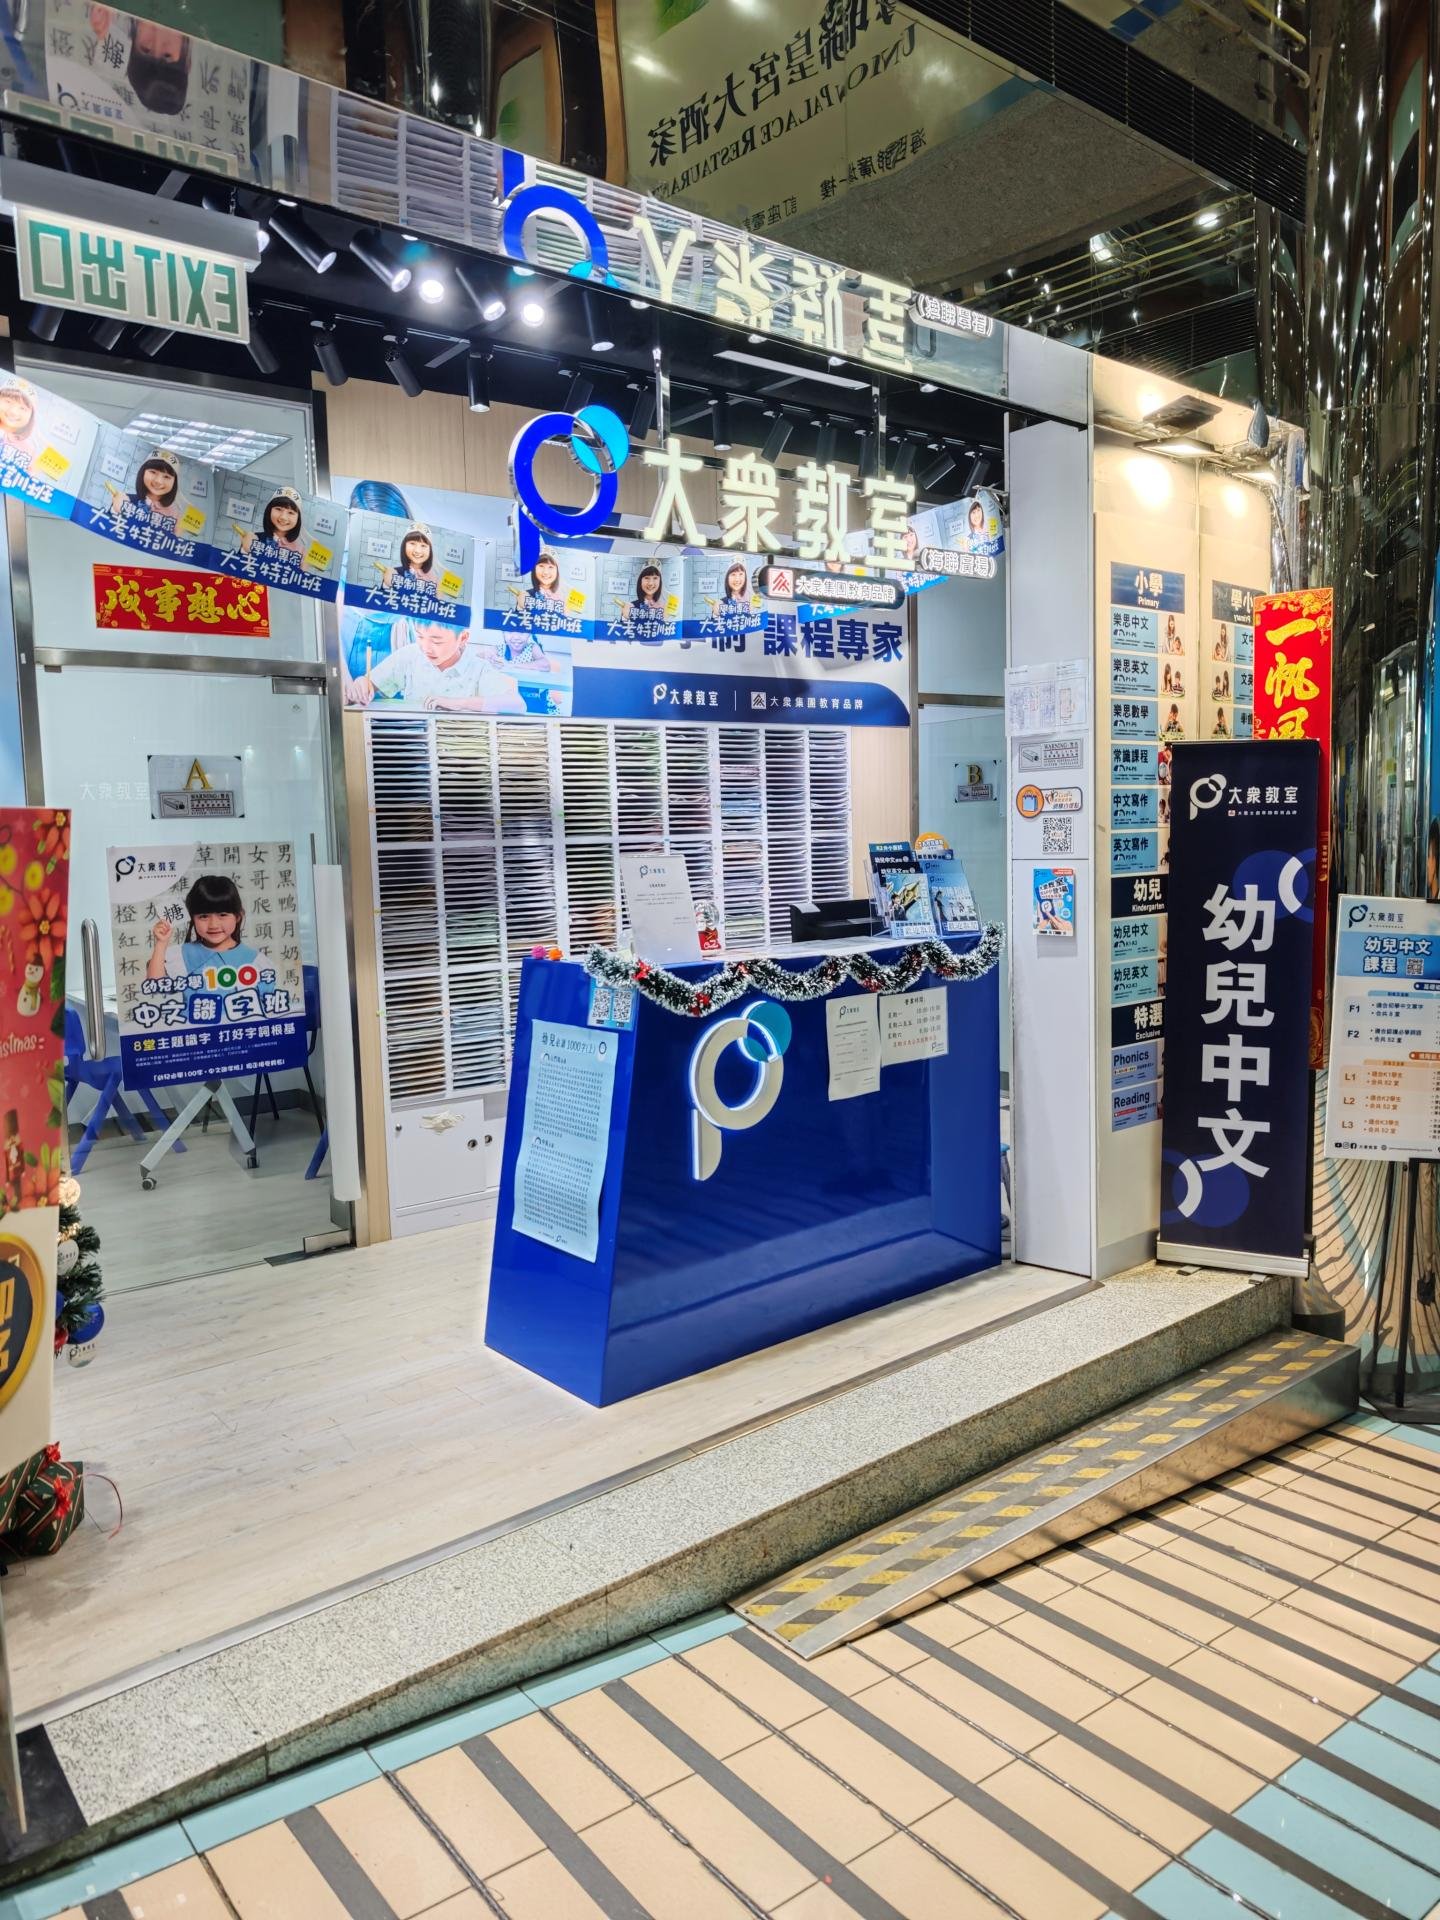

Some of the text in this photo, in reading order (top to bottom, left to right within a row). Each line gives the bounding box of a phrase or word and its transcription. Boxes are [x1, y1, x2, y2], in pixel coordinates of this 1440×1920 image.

[88, 506, 195, 557] 大考特訓班
[220, 551, 322, 592] 大考特訓班
[1134, 569, 1163, 596] 小學
[365, 586, 456, 618] 大考特訓班
[1138, 597, 1160, 609] Primary
[502, 609, 582, 633] 大考特訓班
[607, 619, 676, 639] 大考特訓班
[699, 613, 761, 634] 大考特訓班
[1113, 612, 1149, 630] 樂思中文
[1113, 658, 1149, 675] 樂思英文
[1113, 703, 1149, 719] 樂思數學
[1113, 748, 1149, 764] 常識課程
[182, 757, 213, 791] A
[967, 765, 983, 787] B
[1113, 793, 1149, 807] 中文寫作
[223, 847, 240, 864] 開
[248, 845, 268, 863] 女
[278, 845, 291, 863] 男
[1113, 838, 1149, 852] 英文寫作
[250, 870, 294, 889] 哥 黑
[1133, 878, 1162, 901] 幼兒
[163, 904, 184, 923] 糖
[1132, 903, 1165, 913] Kindergarten
[118, 920, 295, 949] 紅 頭 月
[1113, 923, 1149, 939] 幼兒中文
[1365, 936, 1432, 955] 幼兒中文
[119, 945, 299, 976] 杯 奶
[1363, 956, 1397, 973] 課程
[142, 966, 275, 995] 幼兒必學100字
[283, 970, 299, 985] 馬
[1113, 965, 1149, 982] 幼兒英文
[133, 988, 290, 1028] 中文識字班
[1134, 1002, 1163, 1030] 特選
[1349, 1004, 1360, 1013] F1
[133, 1023, 295, 1052] 8堂主題識字 打好字詞根基
[1135, 1029, 1161, 1040] Exclusive
[1198, 883, 1276, 1178] 幼兒中文
[1347, 1030, 1360, 1038] F2
[1114, 1051, 1149, 1067] Phonics
[1114, 1092, 1150, 1109] Reading
[1343, 1097, 1355, 1105] L2
